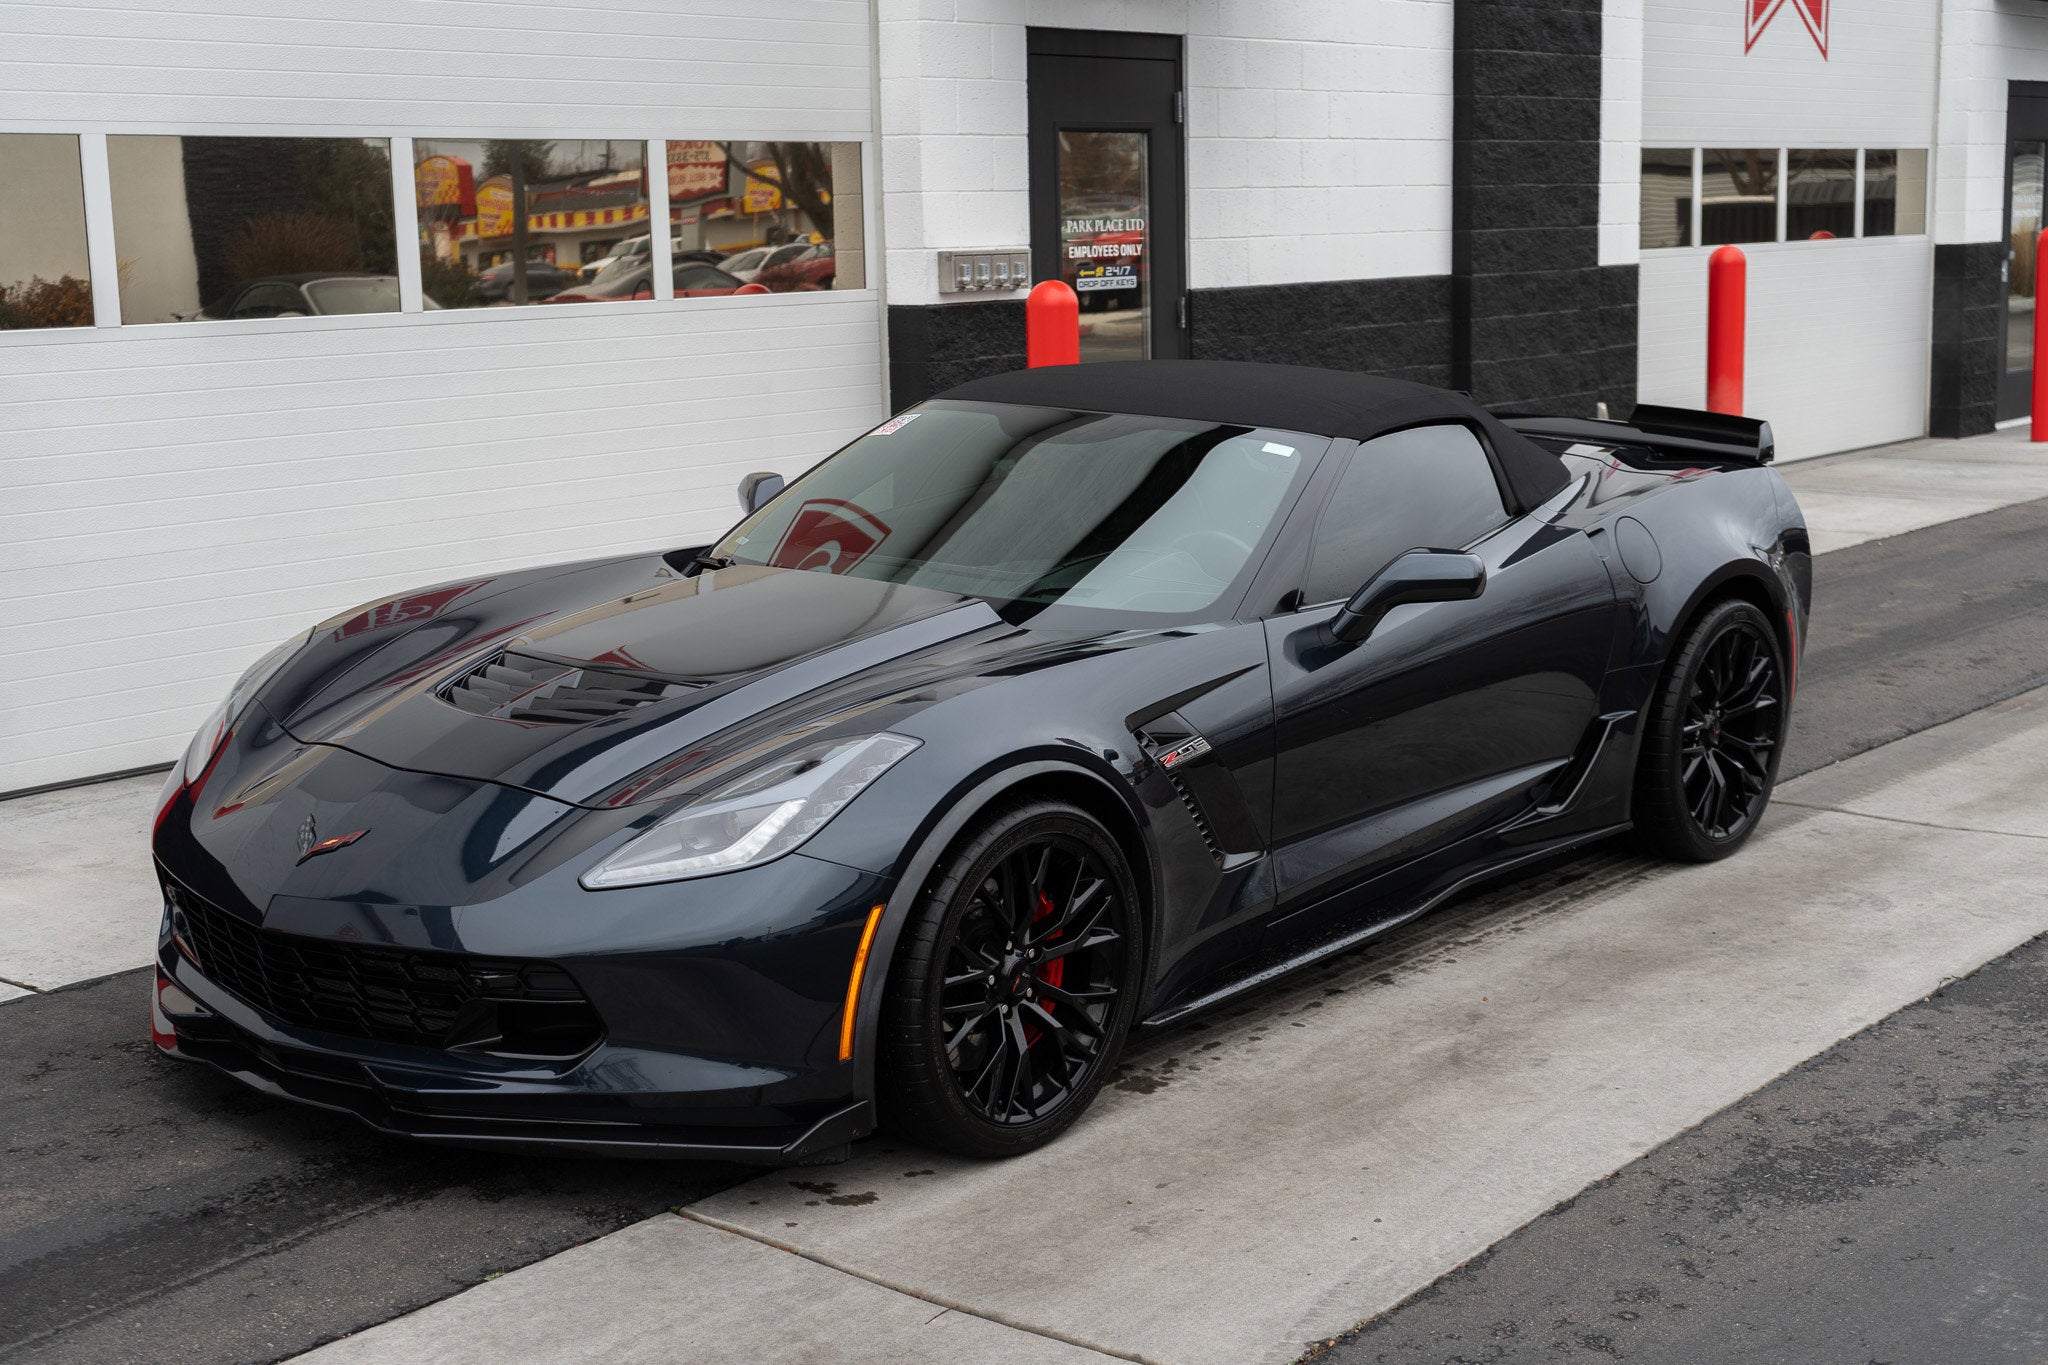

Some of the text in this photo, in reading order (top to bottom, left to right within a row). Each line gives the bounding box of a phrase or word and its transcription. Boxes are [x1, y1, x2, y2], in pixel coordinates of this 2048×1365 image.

[1067, 219, 1144, 232] PARK PLACE LTD
[1068, 244, 1142, 259] EMPLOYEES ONLY
[1105, 265, 1131, 276] 24/7
[1100, 279, 1114, 287] OFF
[1115, 278, 1135, 287] KEYS
